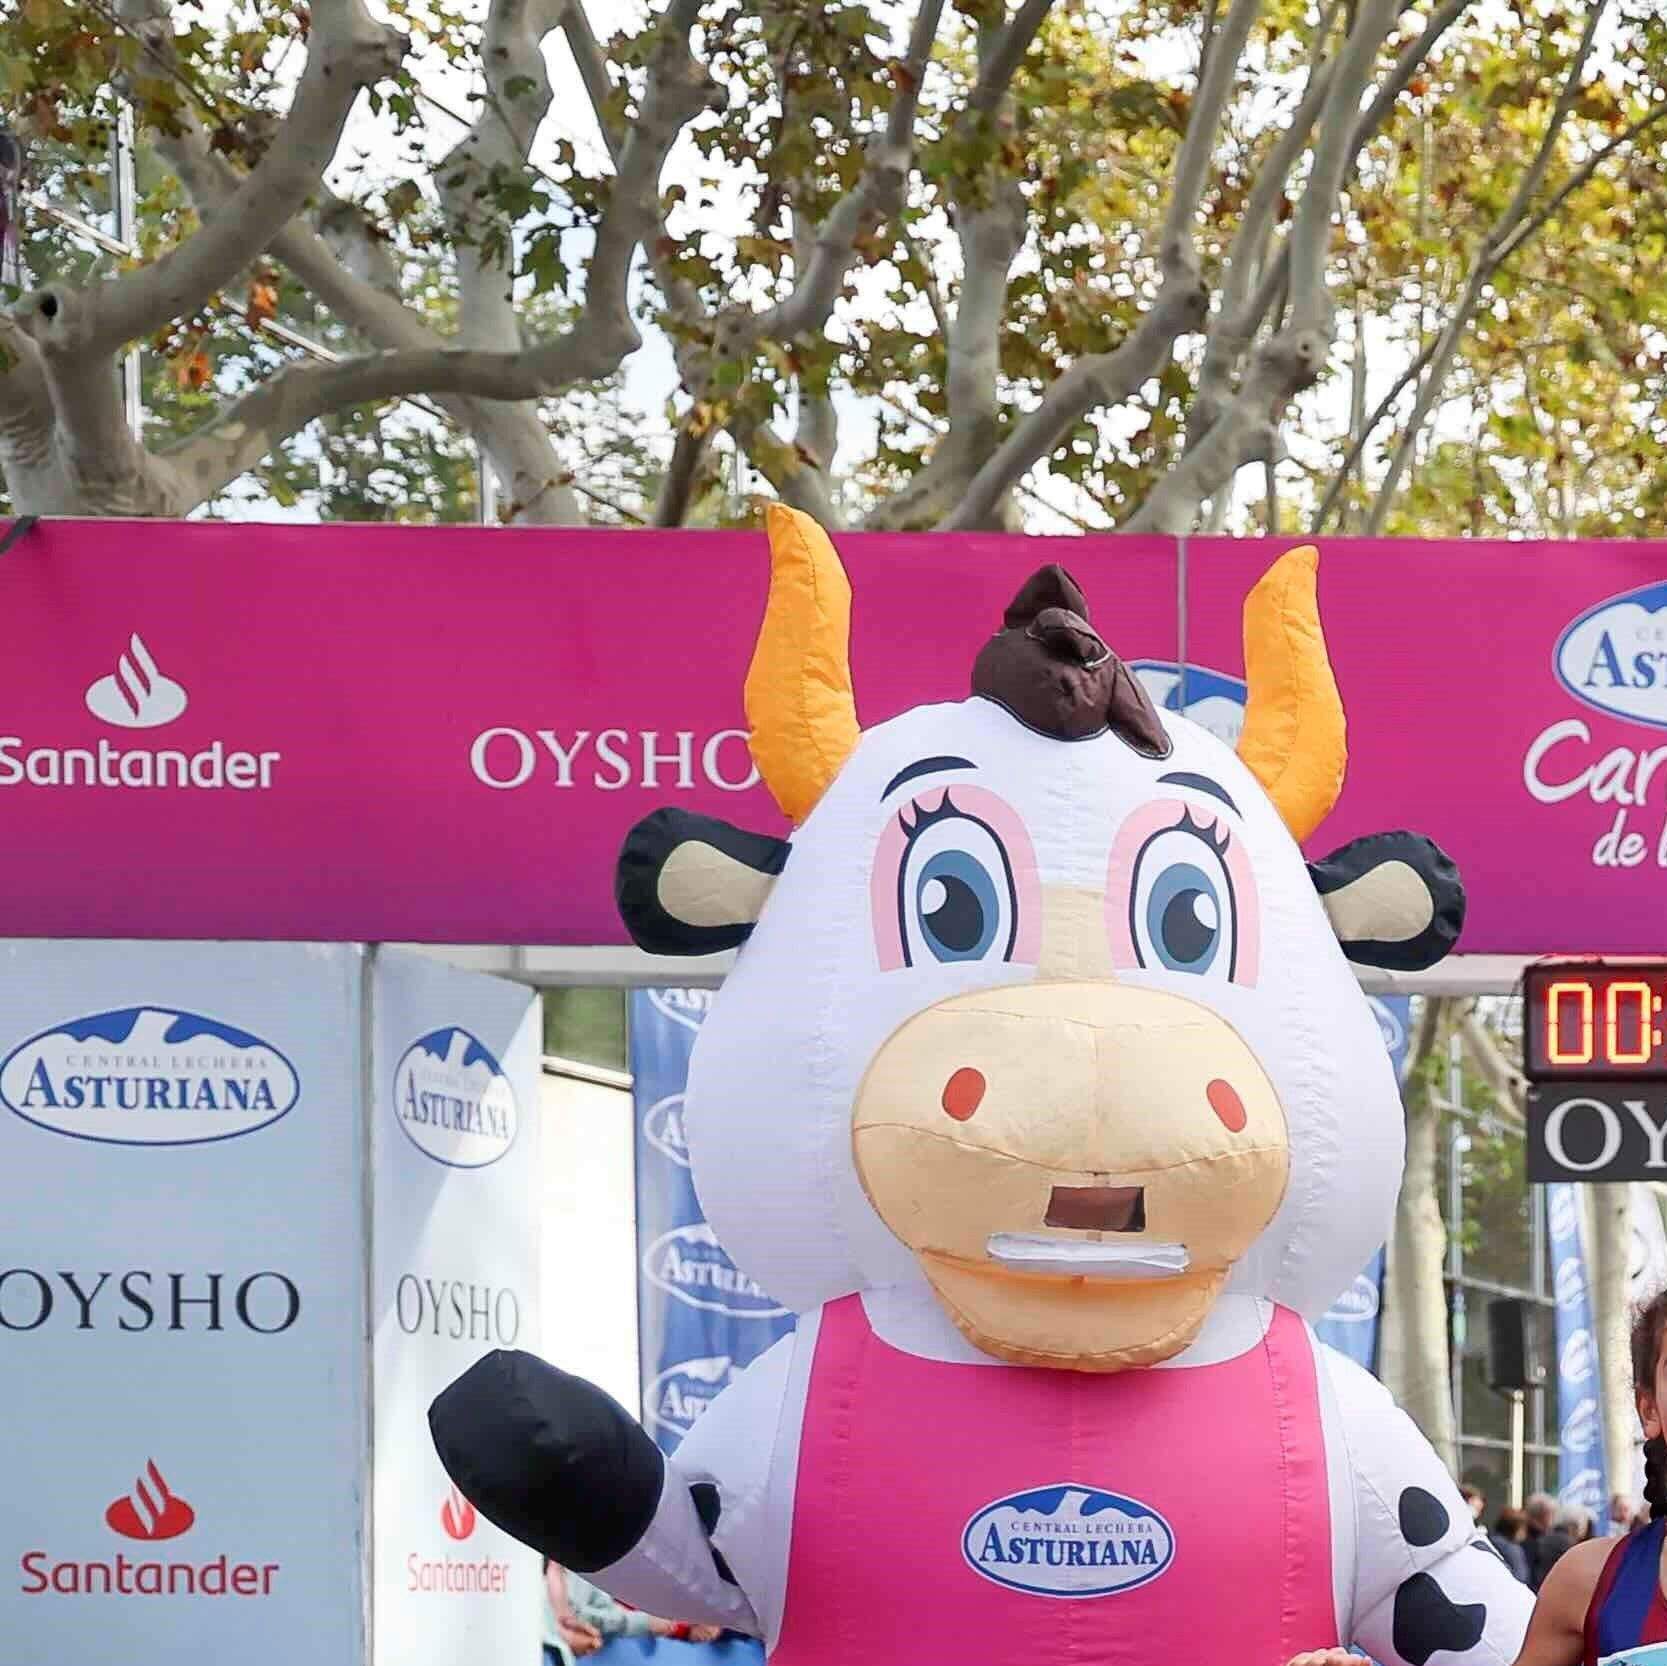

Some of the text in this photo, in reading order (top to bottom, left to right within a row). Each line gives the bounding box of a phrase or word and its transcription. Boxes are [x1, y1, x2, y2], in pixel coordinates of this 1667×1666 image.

[0, 736, 280, 790] Santander
[470, 727, 760, 792] OYSHO
[1592, 808, 1647, 868] de
[20, 1057, 278, 1112] ASTURIANA
[66, 1055, 268, 1070] CENTRAL LECHERA
[403, 1068, 509, 1139] ASTURIANA
[0, 1268, 300, 1334] OYSHO
[397, 1274, 520, 1346] OYSHO
[980, 1521, 1159, 1567] ASTURIANA
[1011, 1521, 1153, 1534] CENTRAL LECHERA
[20, 1550, 280, 1596] Santander
[407, 1552, 509, 1593] Santander
